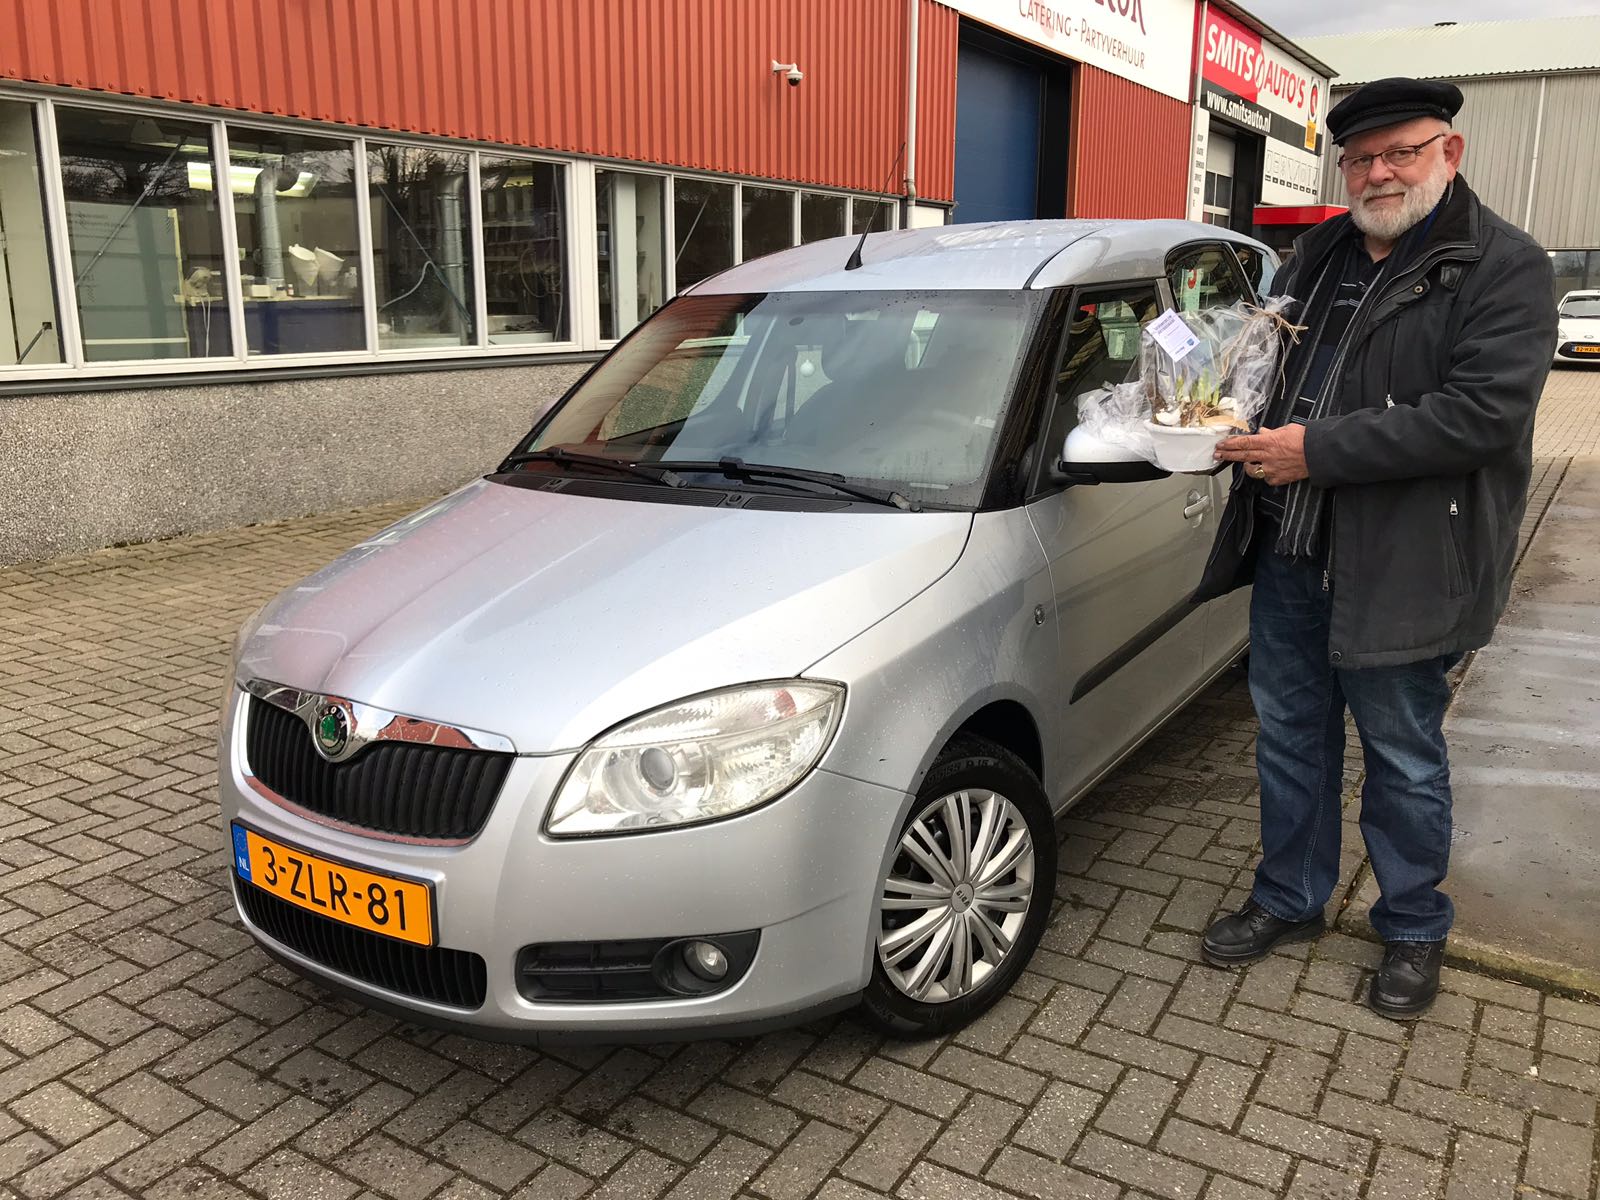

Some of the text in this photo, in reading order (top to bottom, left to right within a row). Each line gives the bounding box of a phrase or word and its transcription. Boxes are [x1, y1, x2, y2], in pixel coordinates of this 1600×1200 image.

[1080, 17, 1145, 69] PARTYVERHUUR
[1206, 23, 1306, 109] SMITS AUTO'S
[1206, 90, 1272, 133] www.smitsauto.nl
[239, 856, 249, 872] NL
[262, 846, 406, 931] 3-ZLR-81
